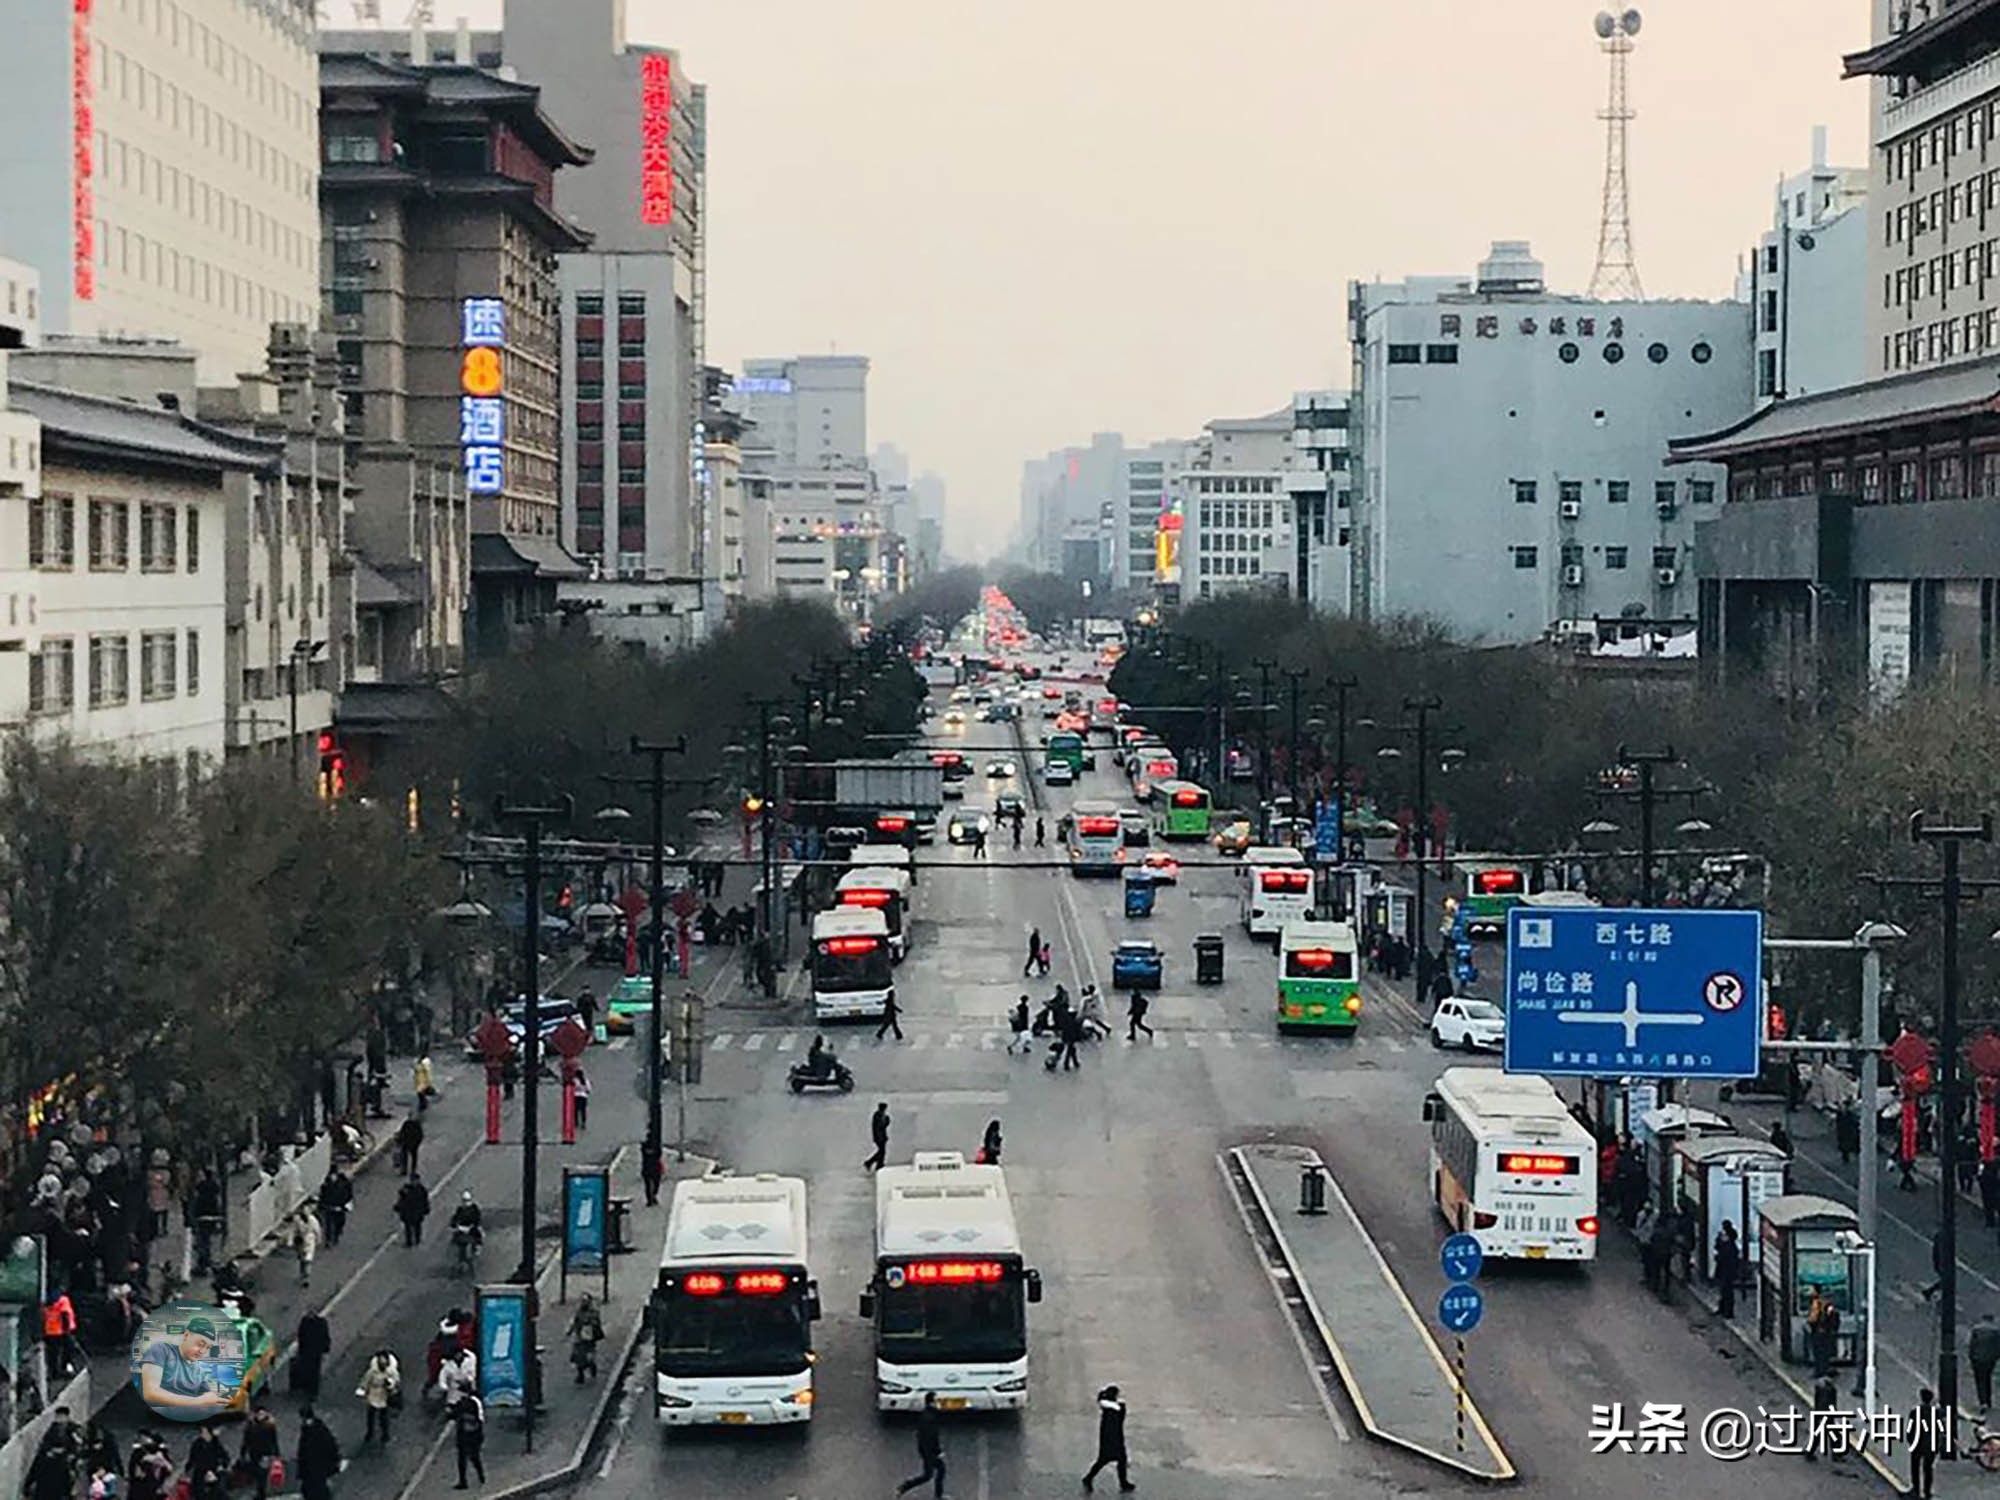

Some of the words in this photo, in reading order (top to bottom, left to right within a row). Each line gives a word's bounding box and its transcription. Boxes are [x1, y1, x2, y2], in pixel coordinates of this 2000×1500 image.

[461, 298, 504, 493] 速8酒店
[1595, 922, 1672, 945] 西七路
[1517, 970, 1594, 993] 尚俭路
